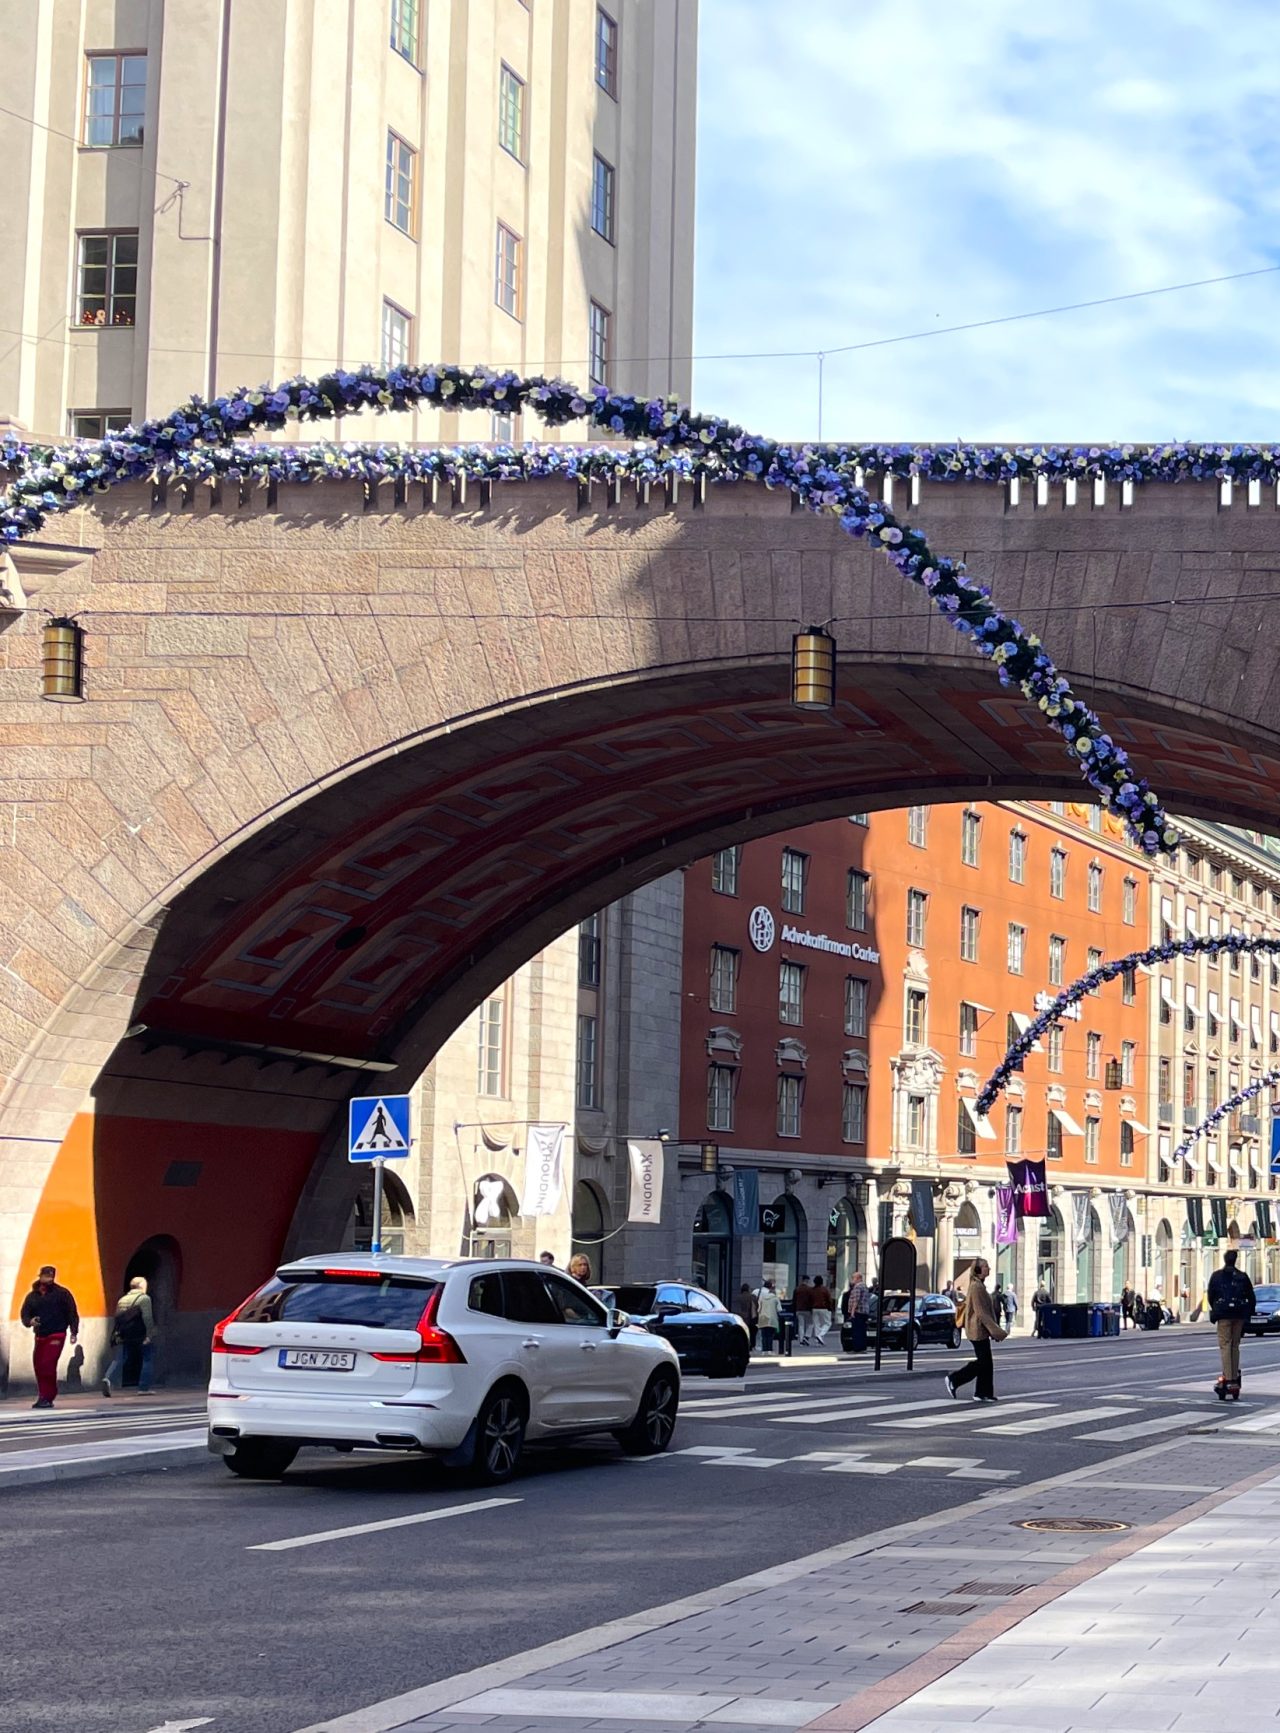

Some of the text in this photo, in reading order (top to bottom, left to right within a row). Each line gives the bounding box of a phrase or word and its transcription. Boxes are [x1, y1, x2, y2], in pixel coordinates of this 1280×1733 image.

[781, 925, 880, 964] Advokatfirman Carler
[642, 1165, 653, 1216] HOUDINI
[1014, 1181, 1045, 1194] Acast
[291, 1353, 348, 1367] JGN 705
